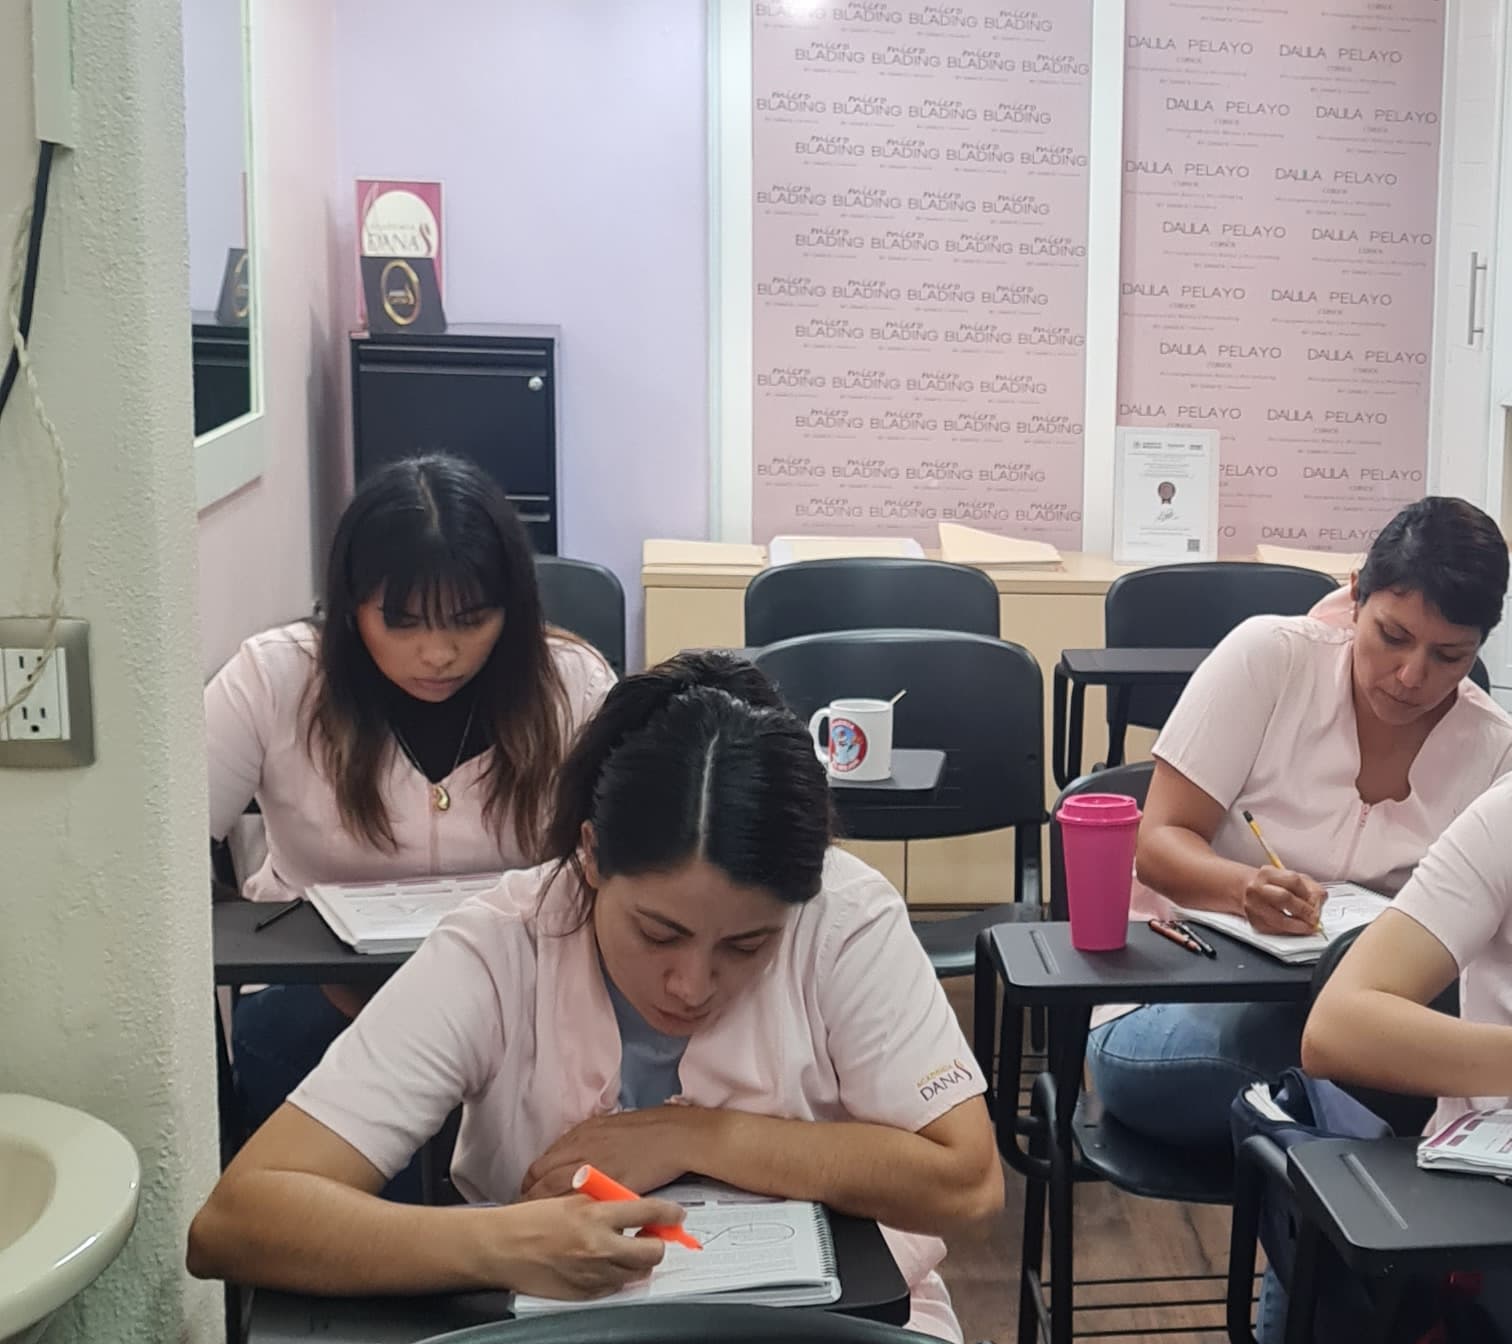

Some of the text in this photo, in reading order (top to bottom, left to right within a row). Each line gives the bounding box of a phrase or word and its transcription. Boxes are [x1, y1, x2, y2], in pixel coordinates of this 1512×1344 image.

[795, 49, 1090, 75] BLADING BLADING BLADING BLADING
[756, 98, 1052, 125] BLADING BLADING BLADING BLADING
[1226, 102, 1290, 117] PELAYO
[1375, 110, 1437, 124] PELAYO
[795, 141, 1088, 167] BLADING BLADING BLADING BLADING
[1222, 224, 1286, 239] PELAYO
[1370, 230, 1432, 245] PELAYO
[795, 234, 1086, 257] BLADING BLADING BLADING BLADING
[757, 283, 1048, 306] BLADING BLADING BLADING BLADING
[1218, 345, 1282, 360] PELAYO
[1365, 350, 1427, 365] PELAYO
[757, 373, 1047, 395] BLADING BLADING BLADING BLADING
[795, 415, 1083, 435] BLADING BLADING BLADING BLADING
